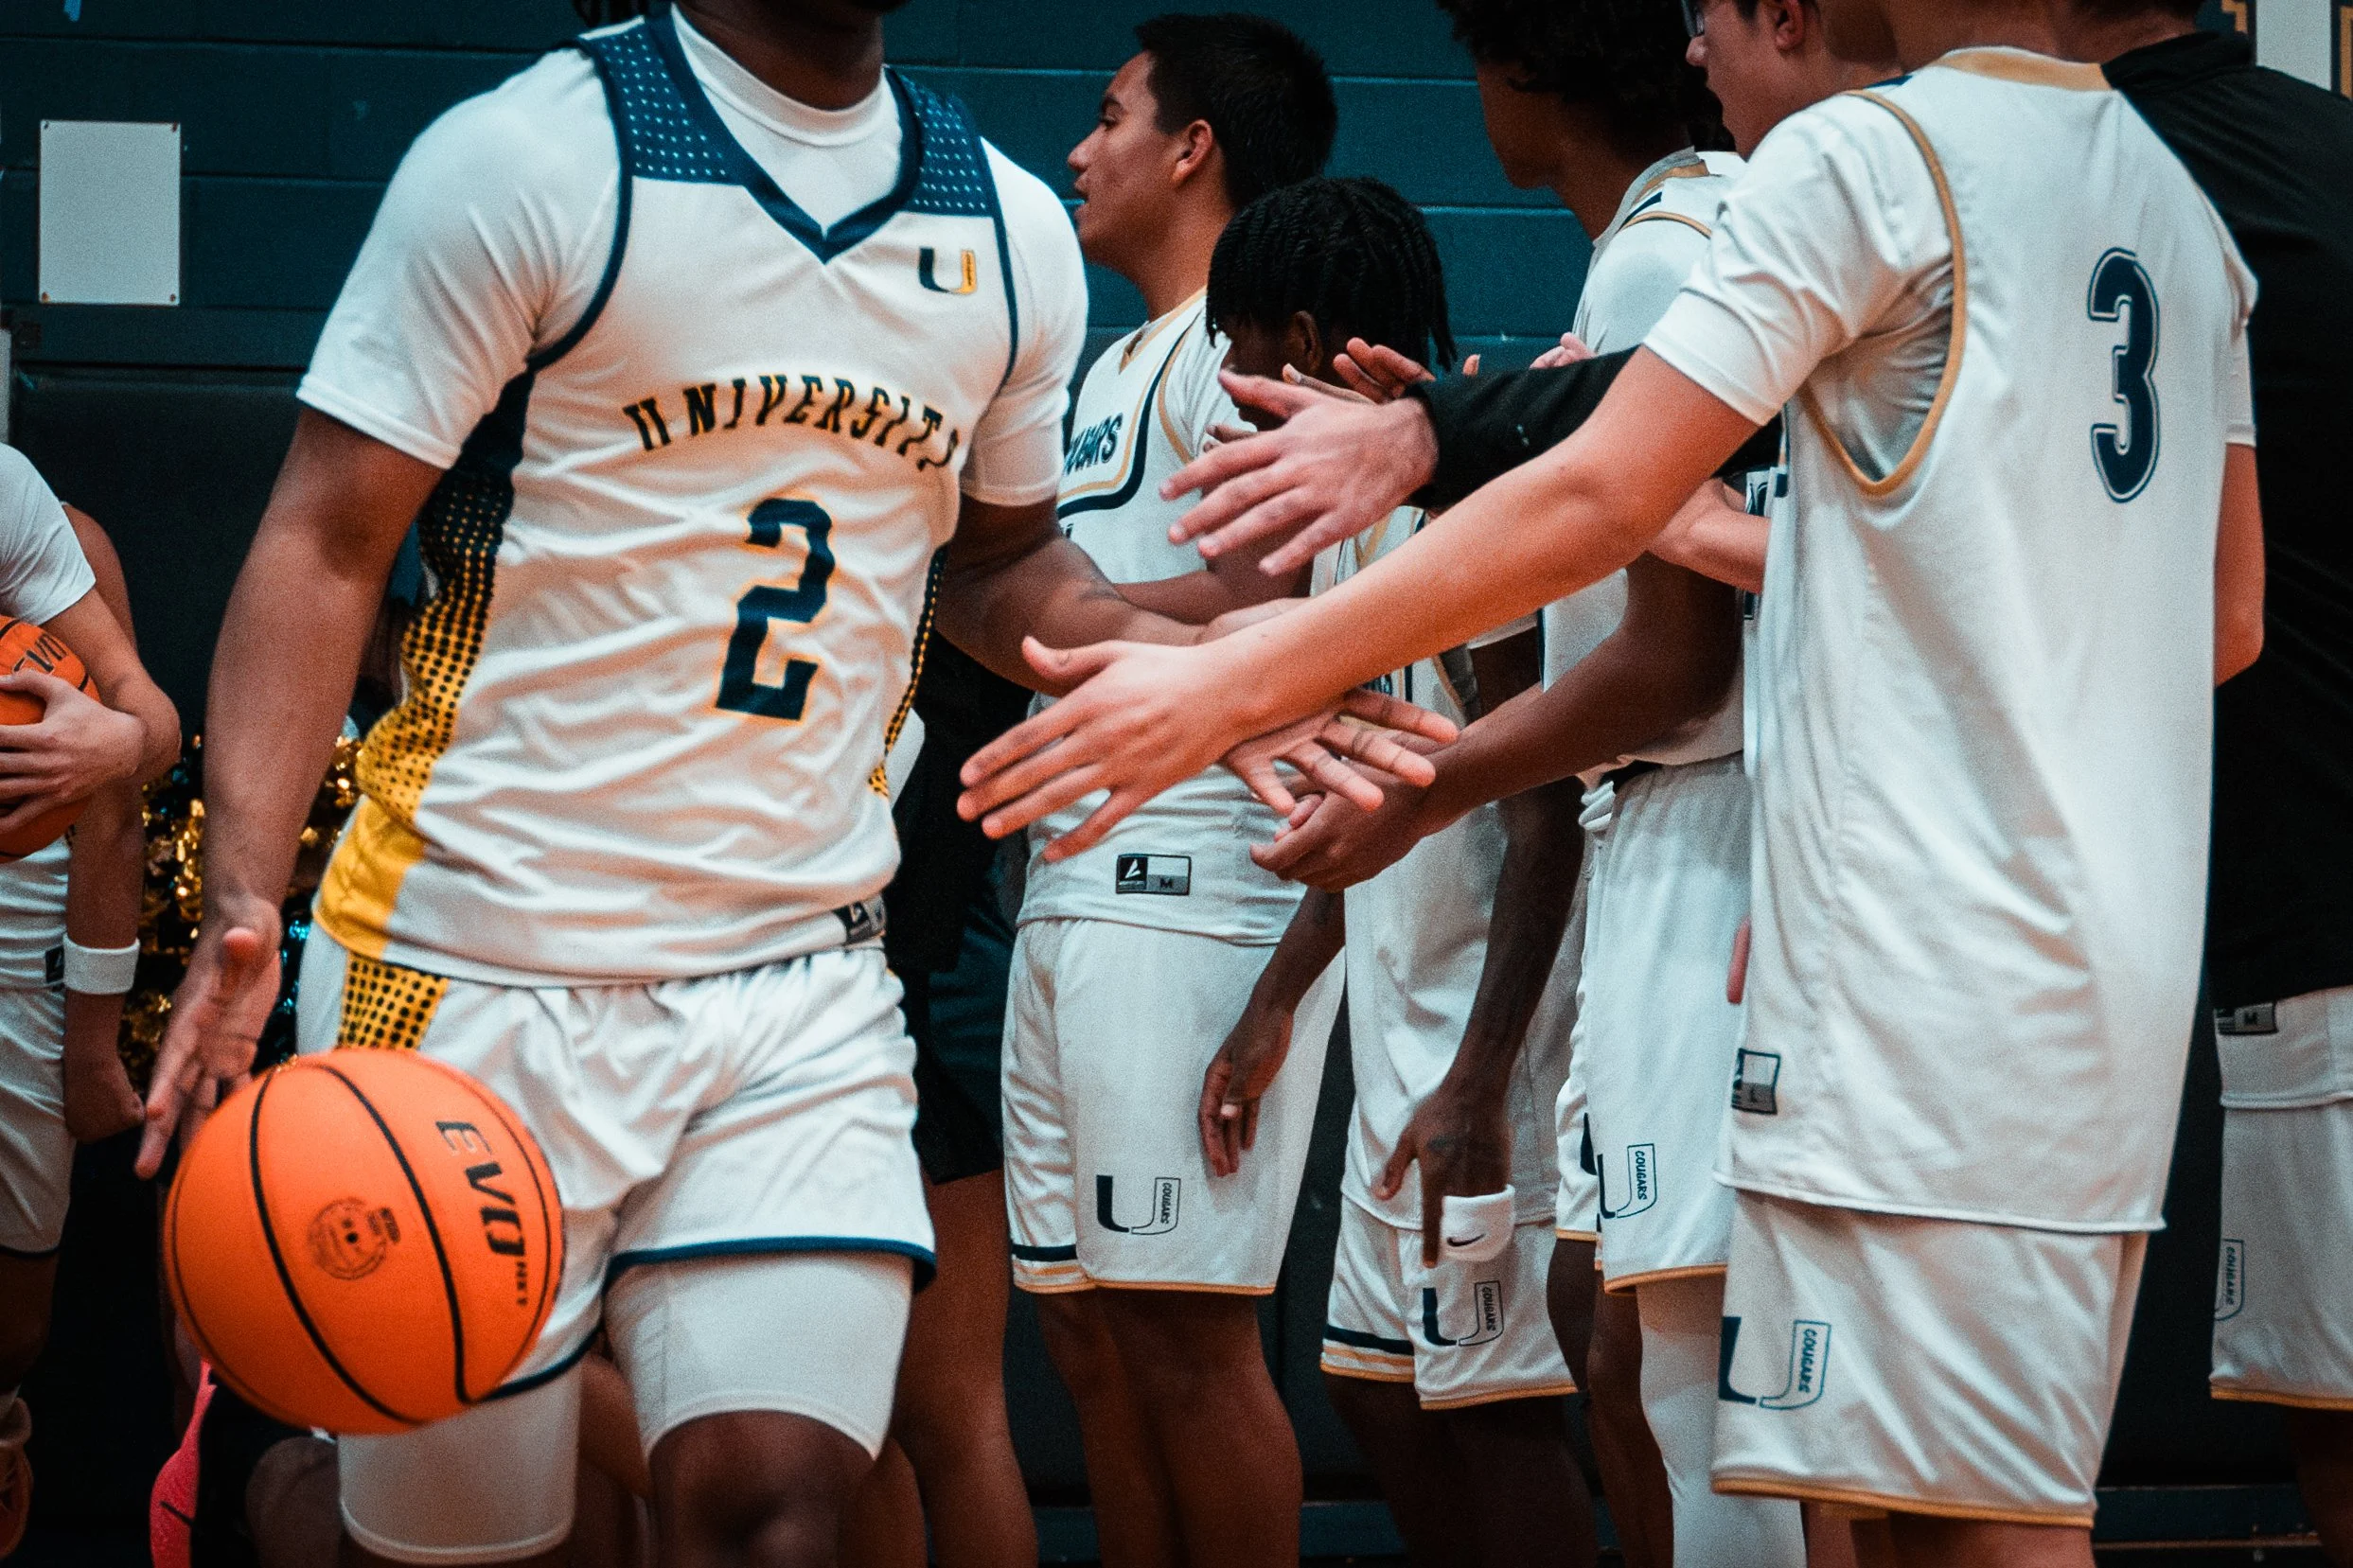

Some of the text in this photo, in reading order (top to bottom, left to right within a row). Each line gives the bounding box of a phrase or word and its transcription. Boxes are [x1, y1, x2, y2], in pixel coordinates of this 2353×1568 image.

[2087, 246, 2161, 503] 3
[715, 498, 836, 722] 2
[435, 1119, 527, 1257] EVO
[1160, 1182, 1173, 1224] COUGARS
[1635, 1150, 1648, 1201] COUGARS
[1481, 1286, 1496, 1331] COUGARS
